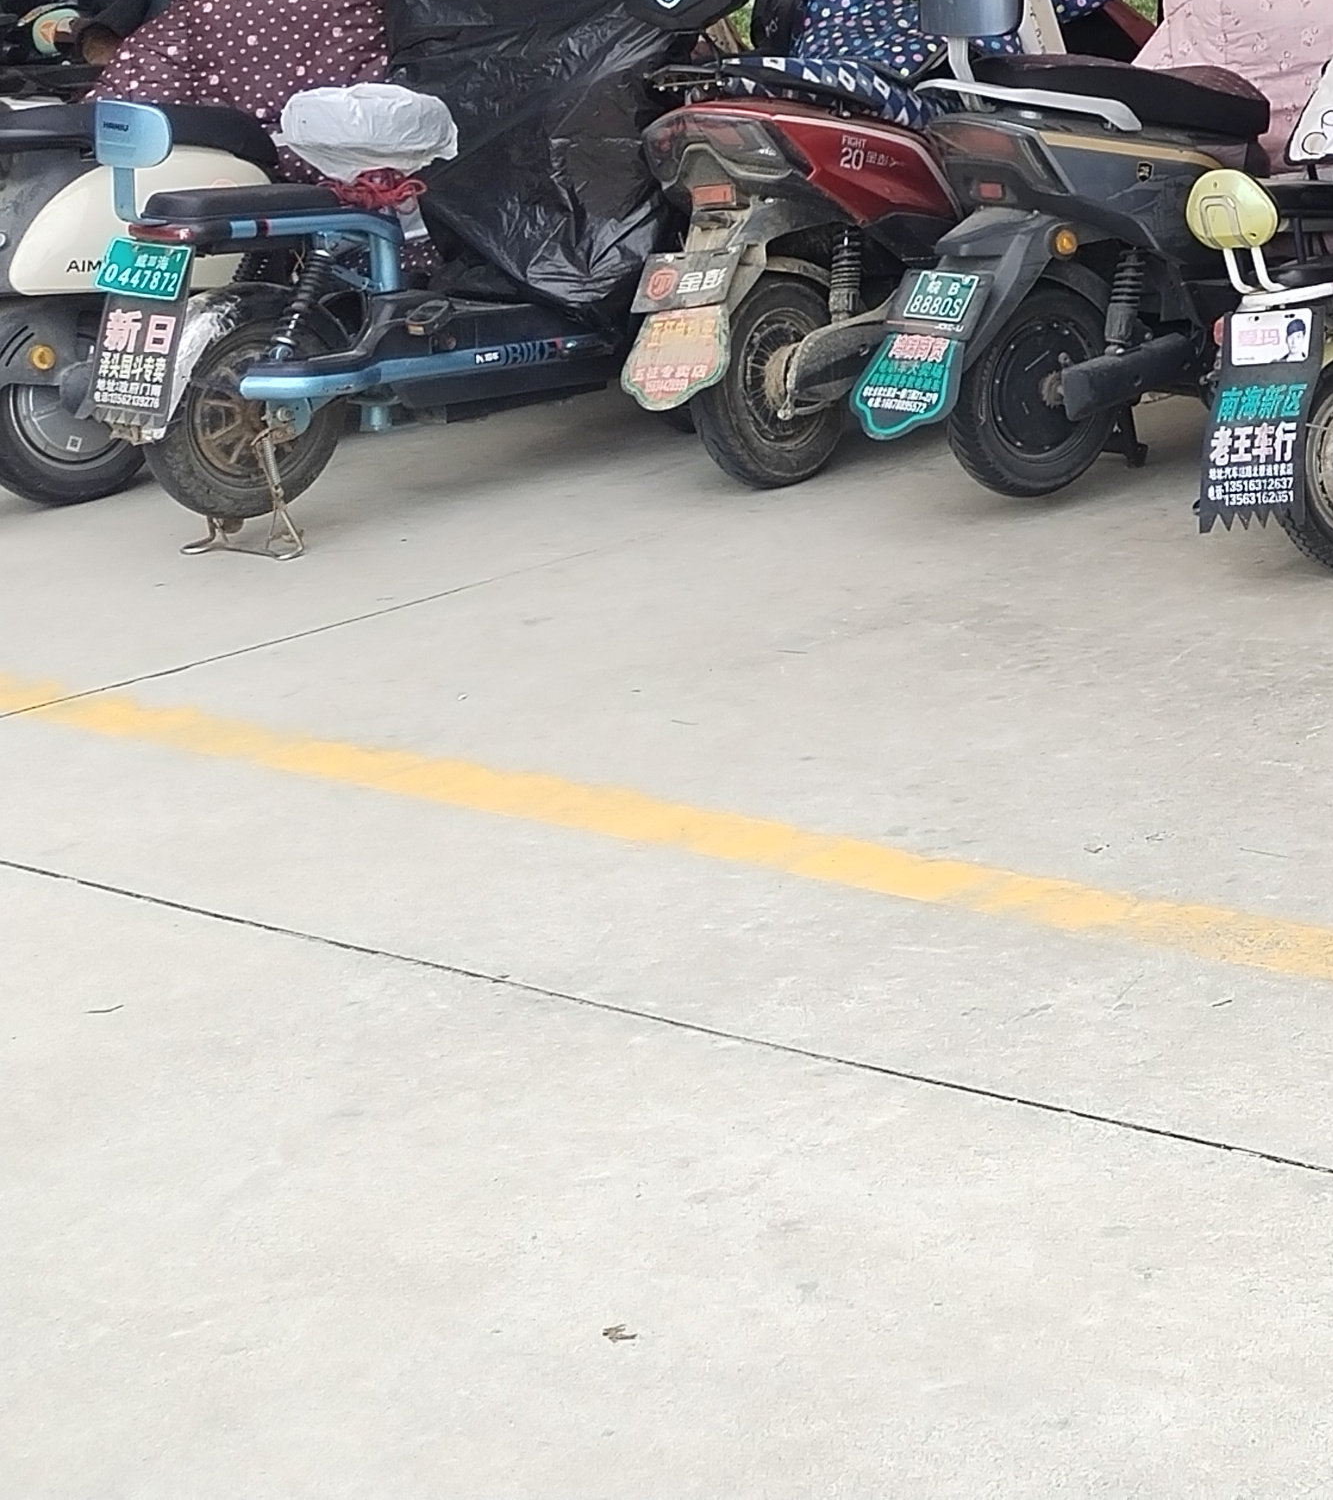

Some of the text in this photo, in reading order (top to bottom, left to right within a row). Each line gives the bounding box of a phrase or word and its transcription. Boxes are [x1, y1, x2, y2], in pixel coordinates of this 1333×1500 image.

[842, 134, 867, 148] FIGHT
[840, 147, 865, 171] 20
[104, 264, 179, 292] 0447872
[676, 267, 728, 295] 金彭
[103, 308, 177, 354] 新日
[1216, 383, 1308, 422] 南海新区
[1209, 421, 1298, 467] 老王车行
